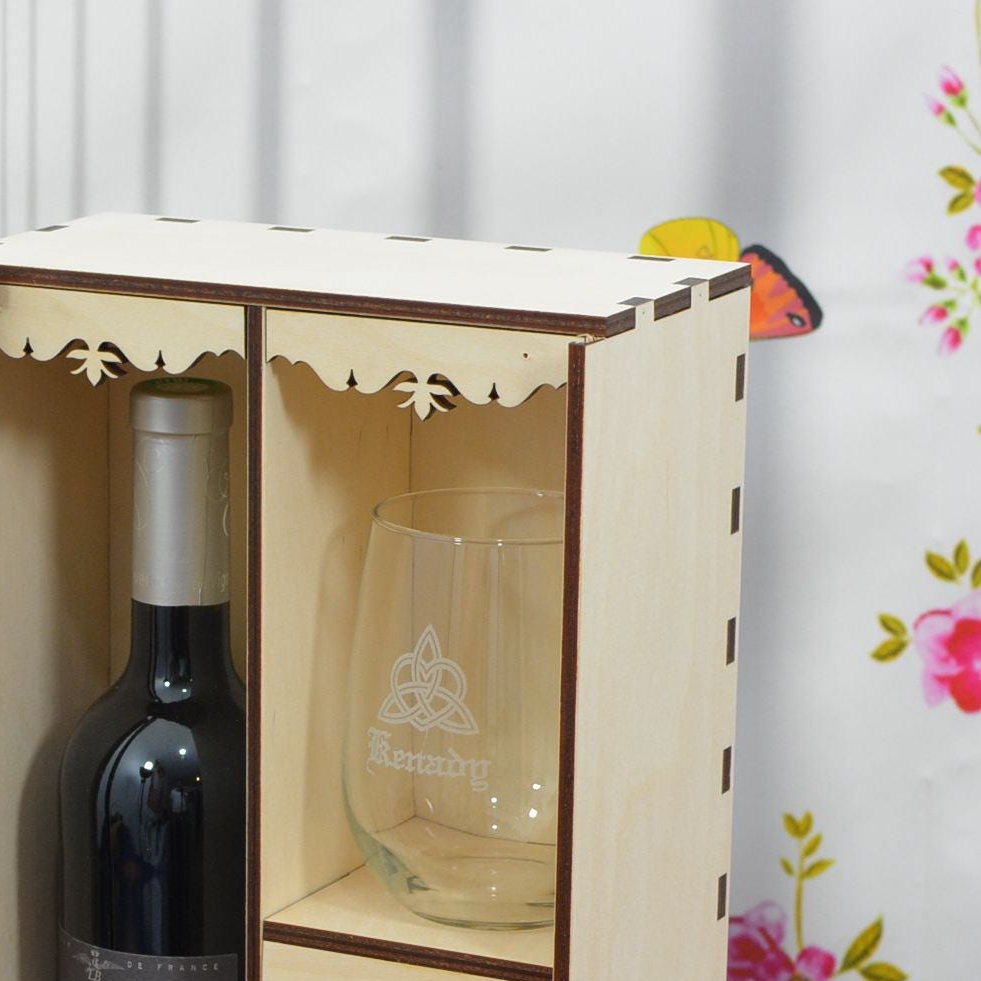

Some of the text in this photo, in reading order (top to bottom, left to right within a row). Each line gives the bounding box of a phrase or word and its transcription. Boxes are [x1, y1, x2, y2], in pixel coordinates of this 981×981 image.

[367, 727, 492, 792] Kenady
[127, 960, 219, 971] DE FRANCE
